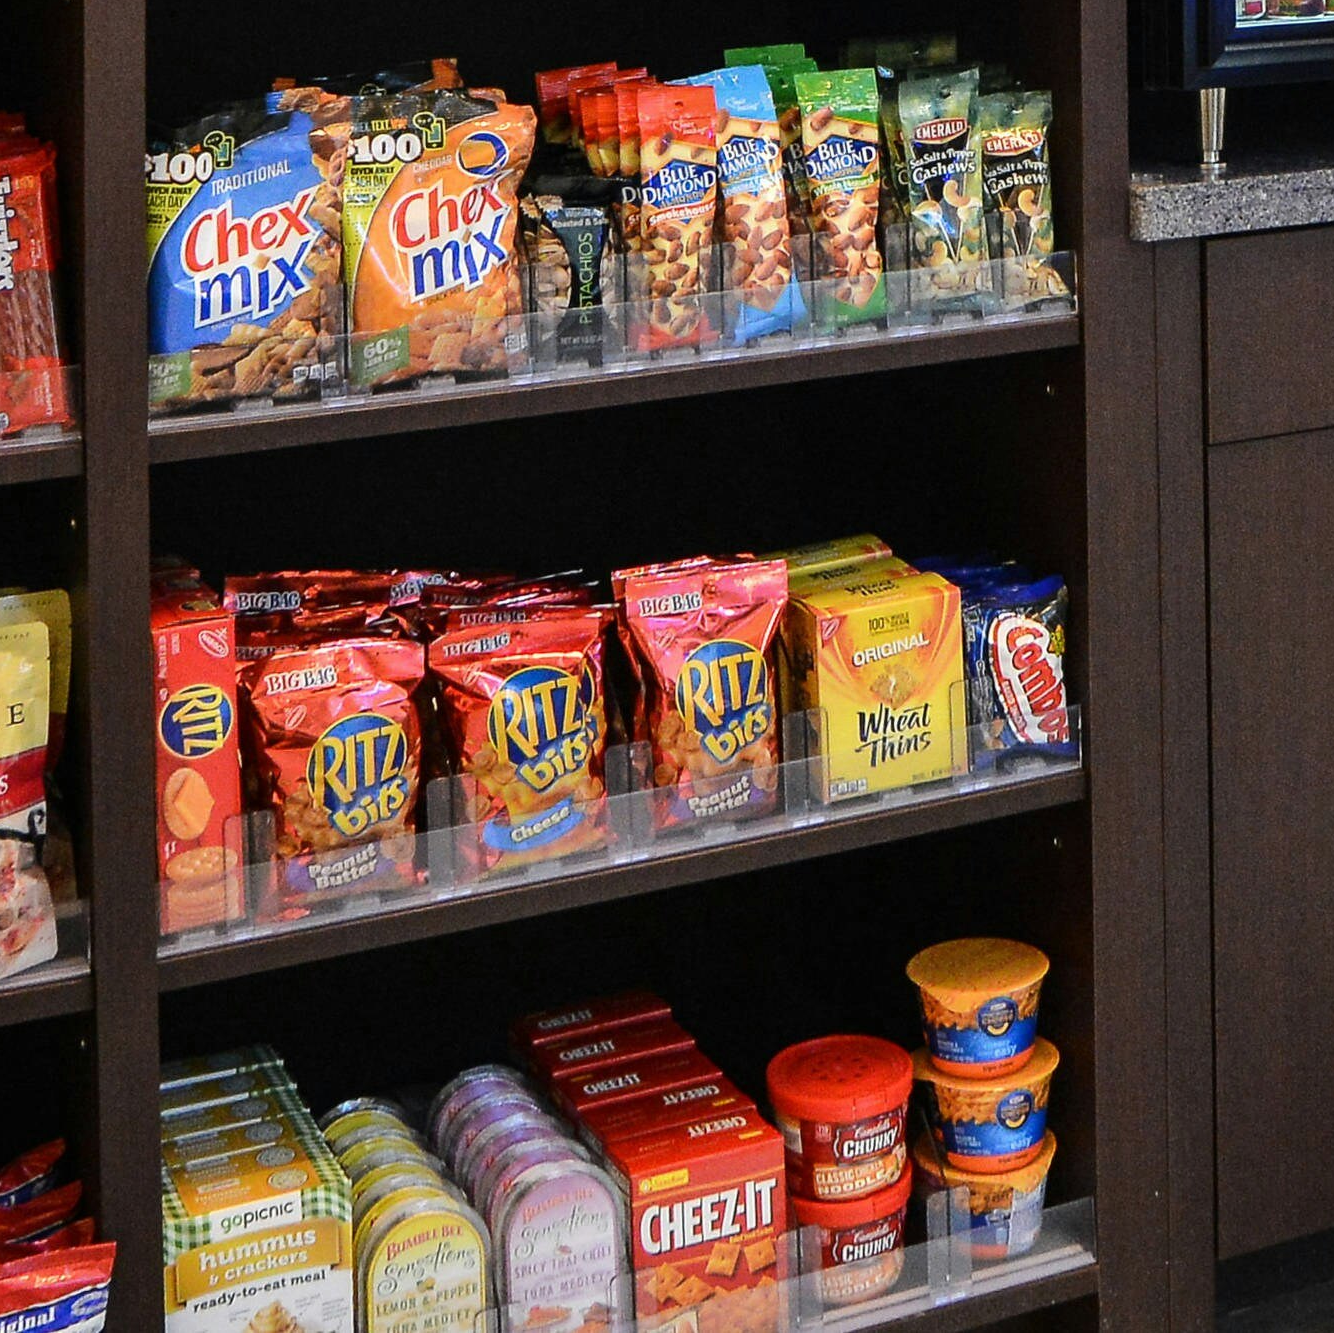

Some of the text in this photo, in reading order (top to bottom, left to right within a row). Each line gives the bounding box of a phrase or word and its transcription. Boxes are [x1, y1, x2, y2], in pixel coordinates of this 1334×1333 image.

[916, 120, 964, 139] EMERALD
[722, 139, 758, 161] BLUE
[805, 144, 877, 178] DIAMOND
[818, 139, 855, 161] BLUE
[211, 158, 292, 197] TRADITIONAL
[642, 170, 716, 204] DIAMOND
[659, 165, 699, 186] BLUE
[911, 160, 976, 186] Cashews
[184, 191, 316, 274] Chex
[392, 178, 502, 249] Chex
[413, 214, 507, 298] mix
[197, 240, 312, 323] mix
[579, 232, 595, 325] PISTACHIOS
[637, 592, 702, 616] BIG BAG
[852, 633, 930, 667] ORIGINAL
[265, 665, 337, 695] BIG BAG
[682, 651, 764, 736] RITZ
[496, 676, 581, 769] RITZ
[703, 706, 769, 762] bits
[856, 702, 932, 743] Wheat
[313, 723, 403, 813] RITZ
[520, 730, 589, 792] bits
[855, 731, 932, 768] Thins
[330, 778, 406, 837] bits
[510, 804, 571, 843] Cheese
[842, 1126, 899, 1157] CHUNKY
[220, 1201, 295, 1235] gopicnic
[640, 1178, 778, 1255] CHEEZ-IT
[199, 1229, 317, 1272] hummus
[841, 1229, 898, 1263] CHUNKY
[209, 1250, 308, 1287] & crackers
[192, 1269, 326, 1313] ready-to-eat meal
[375, 1297, 417, 1315] LEMON
[435, 1283, 479, 1301] PEPPER
